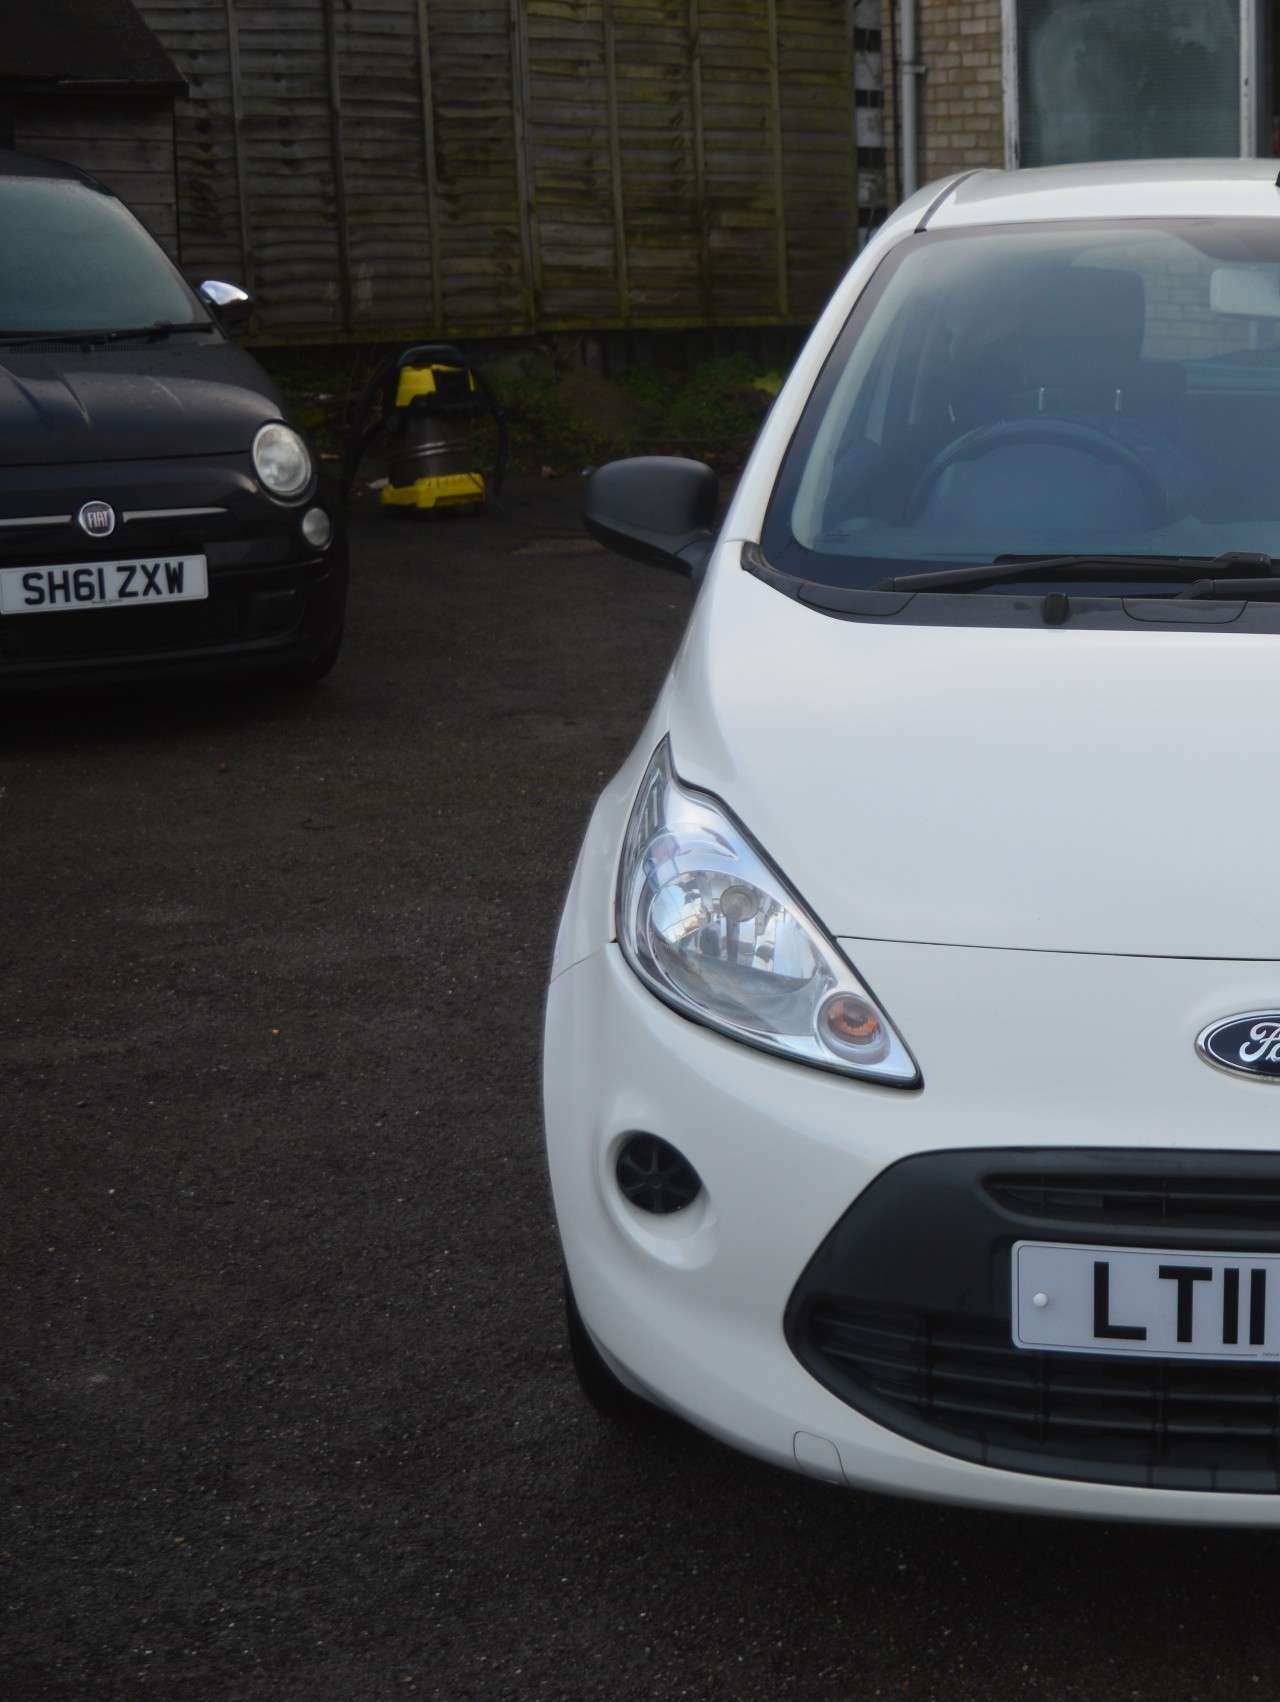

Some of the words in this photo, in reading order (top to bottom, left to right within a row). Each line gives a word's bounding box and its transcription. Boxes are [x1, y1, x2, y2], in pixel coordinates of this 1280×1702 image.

[87, 510, 110, 529] FIAT
[22, 567, 106, 605] SH61
[116, 561, 185, 598] ZXW
[1093, 1260, 1267, 1345] LT11
